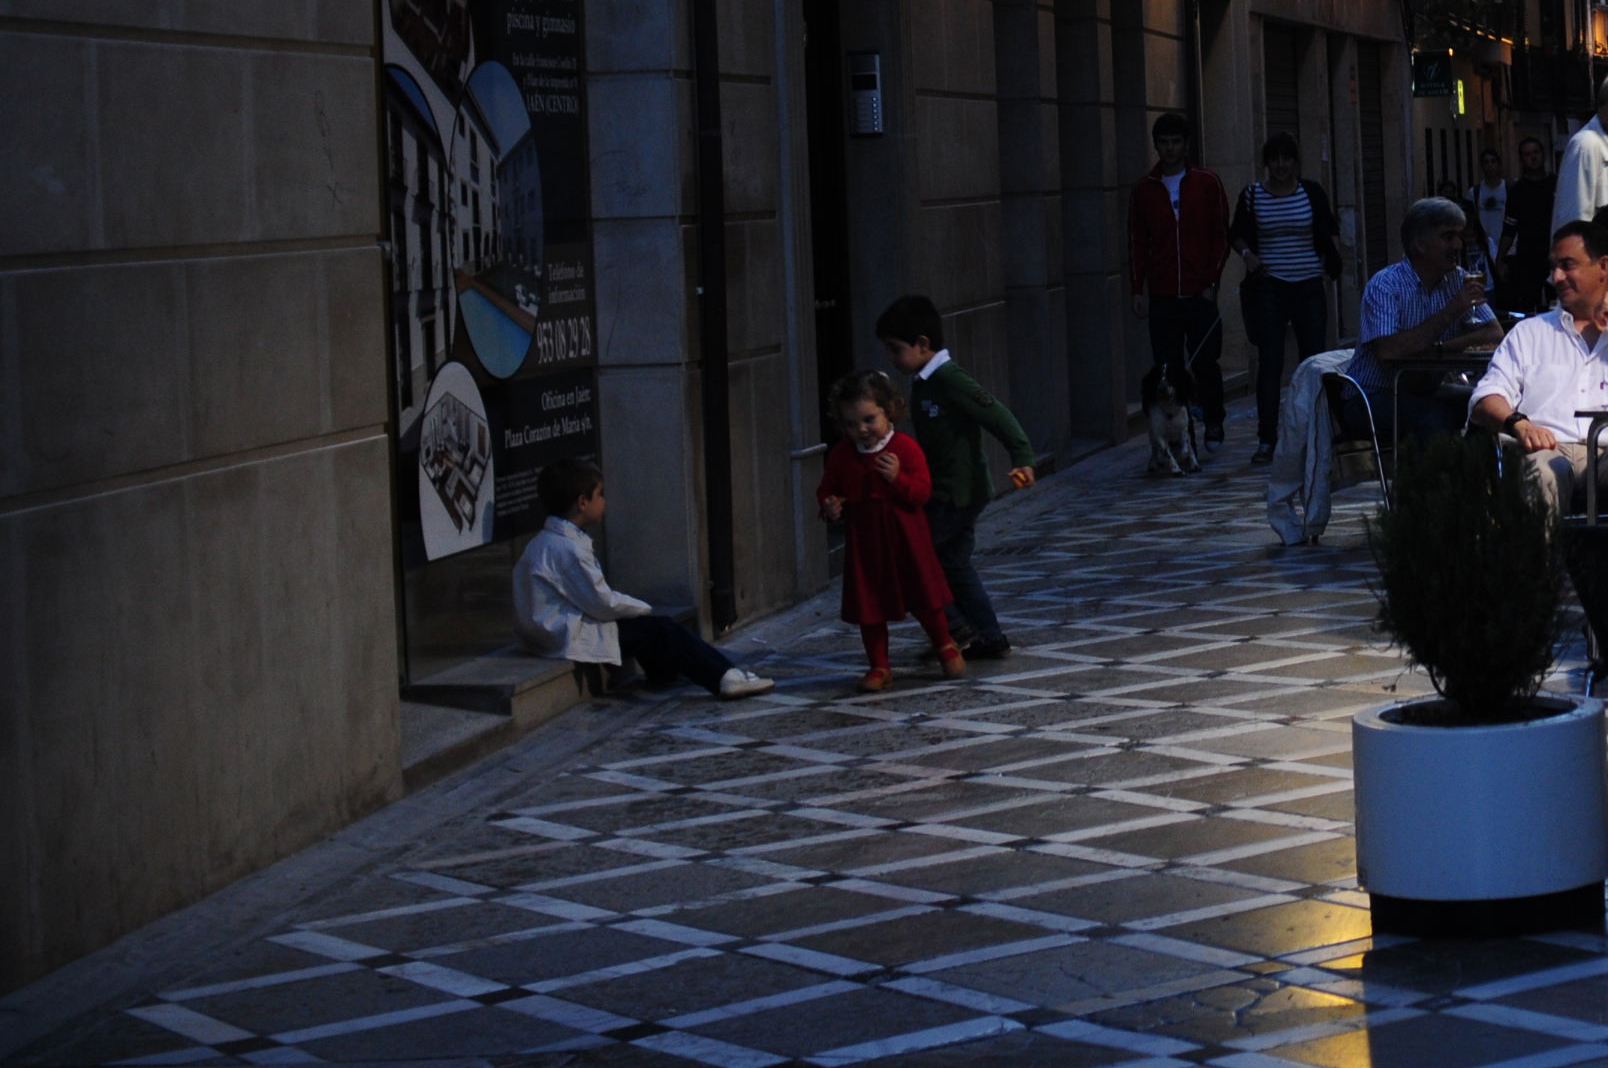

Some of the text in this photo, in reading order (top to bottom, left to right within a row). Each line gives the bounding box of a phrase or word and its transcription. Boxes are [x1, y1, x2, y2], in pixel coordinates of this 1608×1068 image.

[506, 7, 576, 38] piscina y gimnasio
[548, 261, 584, 281] Teléfono de
[548, 284, 586, 304] información
[536, 315, 591, 365] 953 08 29 28
[541, 389, 565, 411] Oficina
[566, 391, 575, 406] en
[504, 428, 523, 449] Plaza
[523, 423, 552, 445] Corazón
[552, 420, 561, 438] de
[561, 416, 580, 436] María
